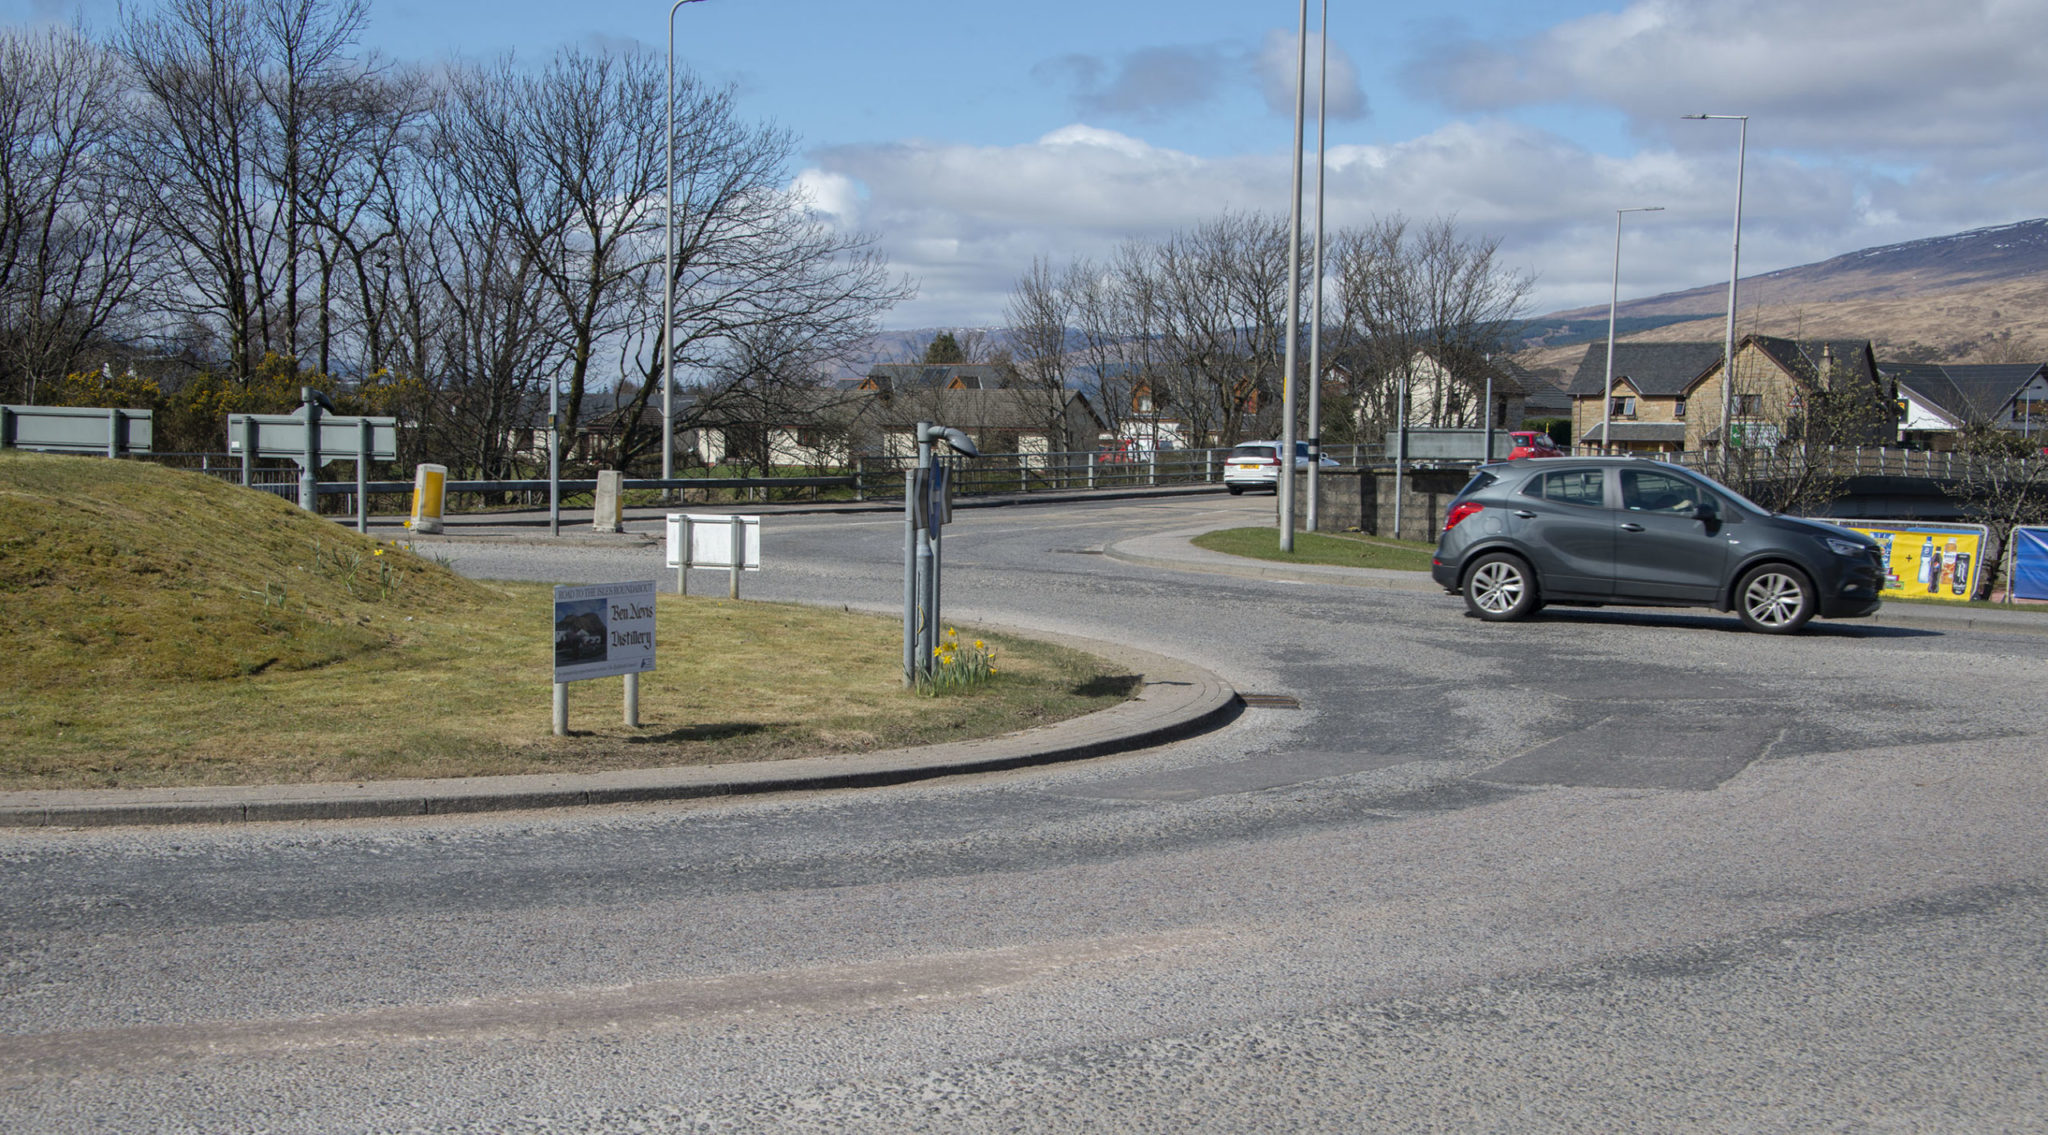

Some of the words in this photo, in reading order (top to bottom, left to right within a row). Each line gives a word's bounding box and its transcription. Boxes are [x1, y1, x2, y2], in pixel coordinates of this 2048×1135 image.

[558, 589, 575, 600] ROAD
[575, 588, 584, 599] TO
[584, 587, 596, 597] THE
[614, 583, 653, 595] ROUNDABOUT
[611, 604, 629, 621] Ben
[629, 602, 653, 620] Nevis
[611, 630, 652, 650] Distillery
